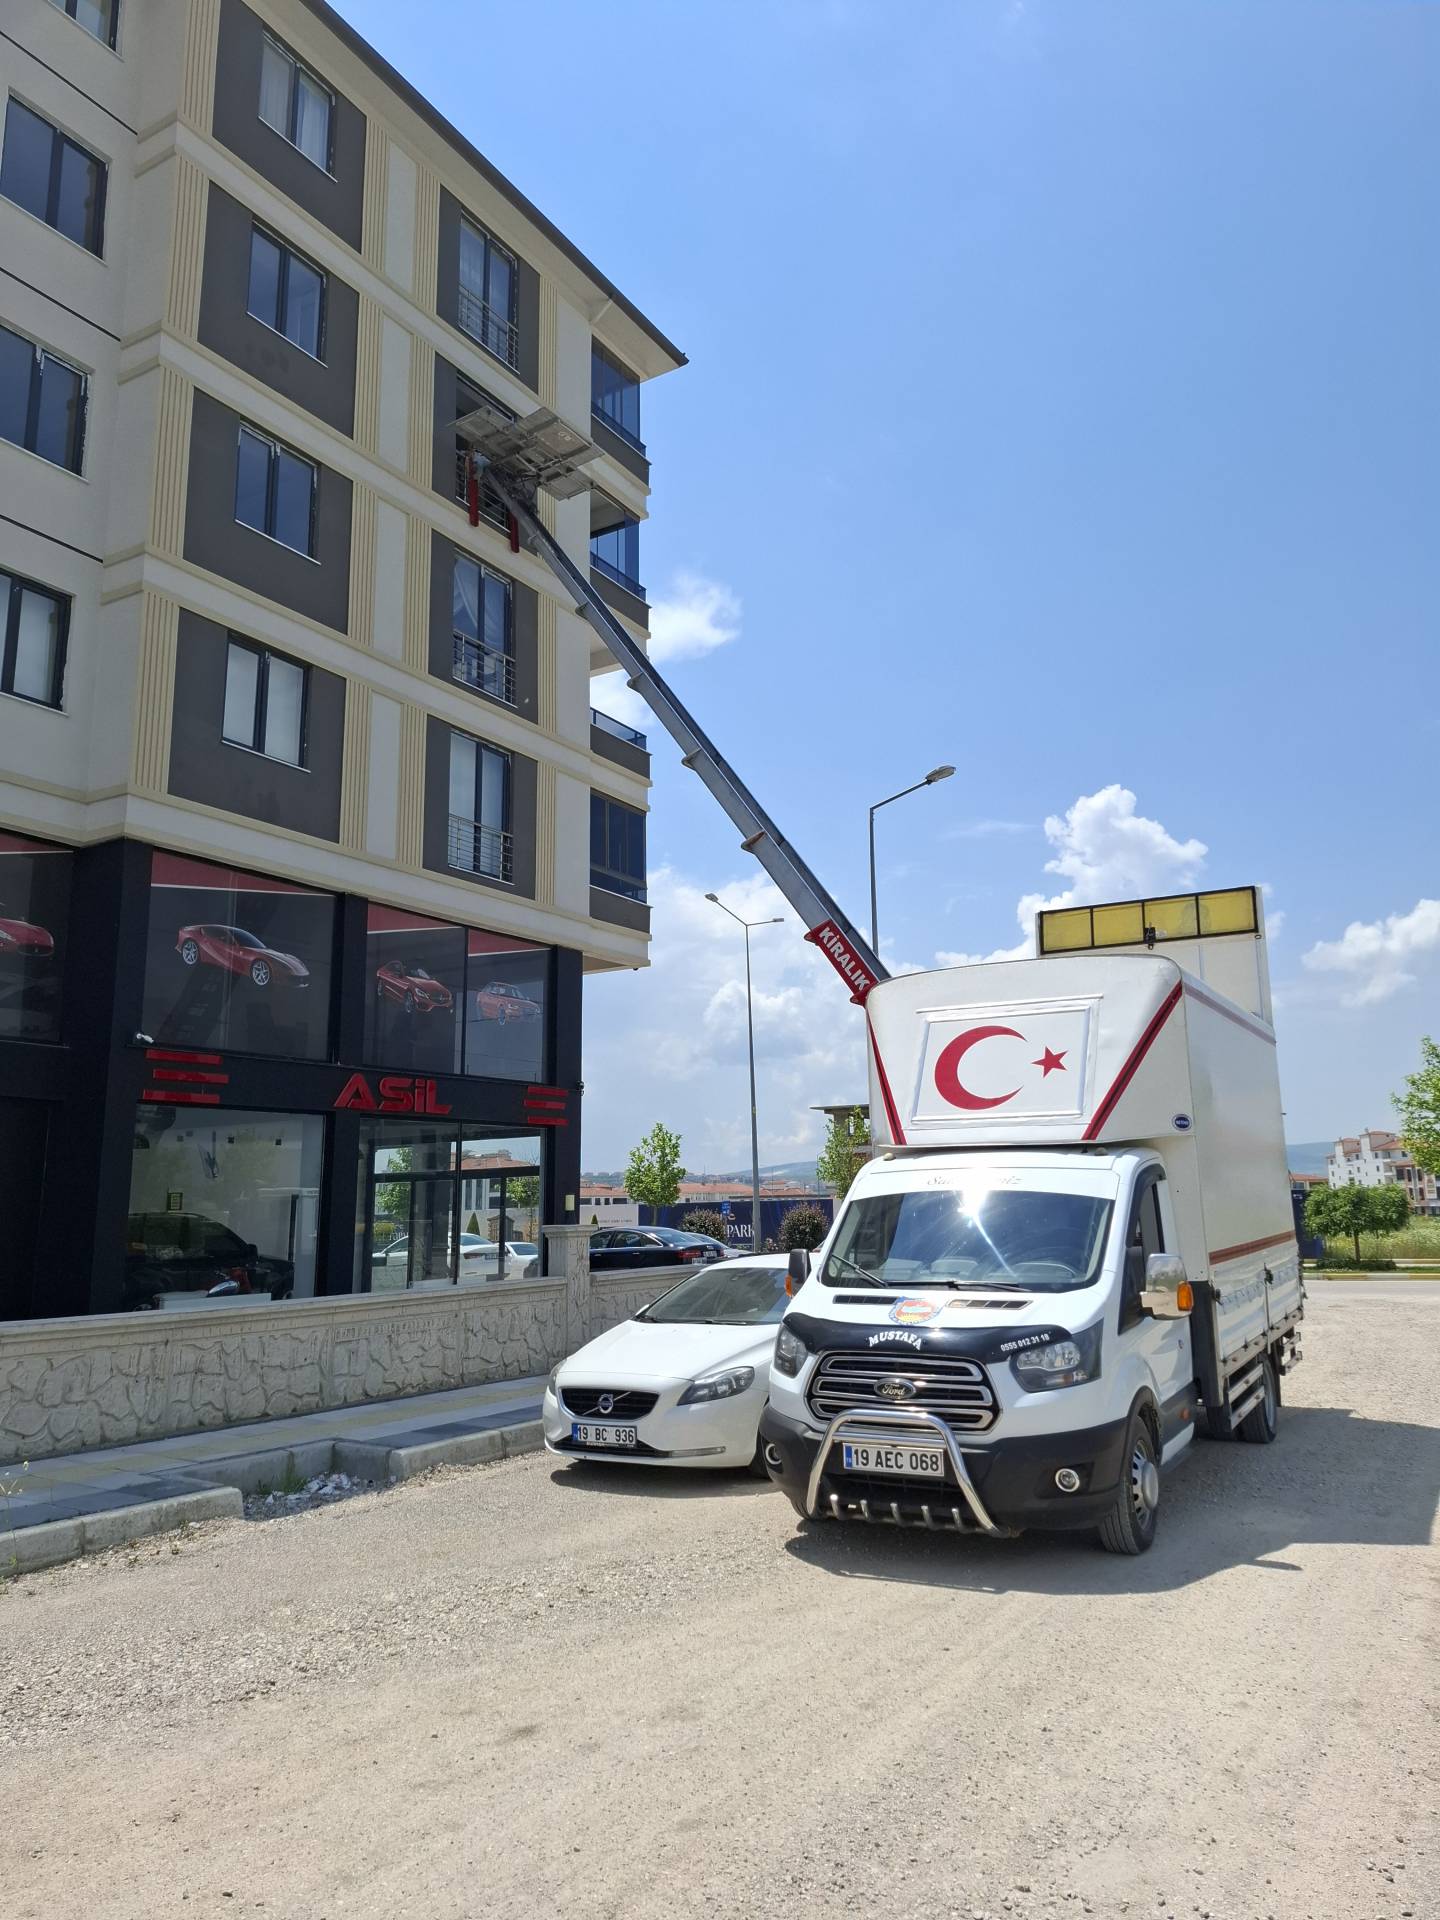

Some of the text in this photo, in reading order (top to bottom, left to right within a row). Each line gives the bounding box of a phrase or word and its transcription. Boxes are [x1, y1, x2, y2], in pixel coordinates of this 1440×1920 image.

[819, 927, 870, 991] KİRALIK
[868, 1330, 922, 1351] MUSTAFA
[1000, 1341, 1018, 1352] 0555
[1017, 1337, 1031, 1348] 012
[881, 1383, 906, 1397] Ford
[578, 1426, 634, 1443] 19 BC 936
[853, 1448, 940, 1472] 19 AEC 068
